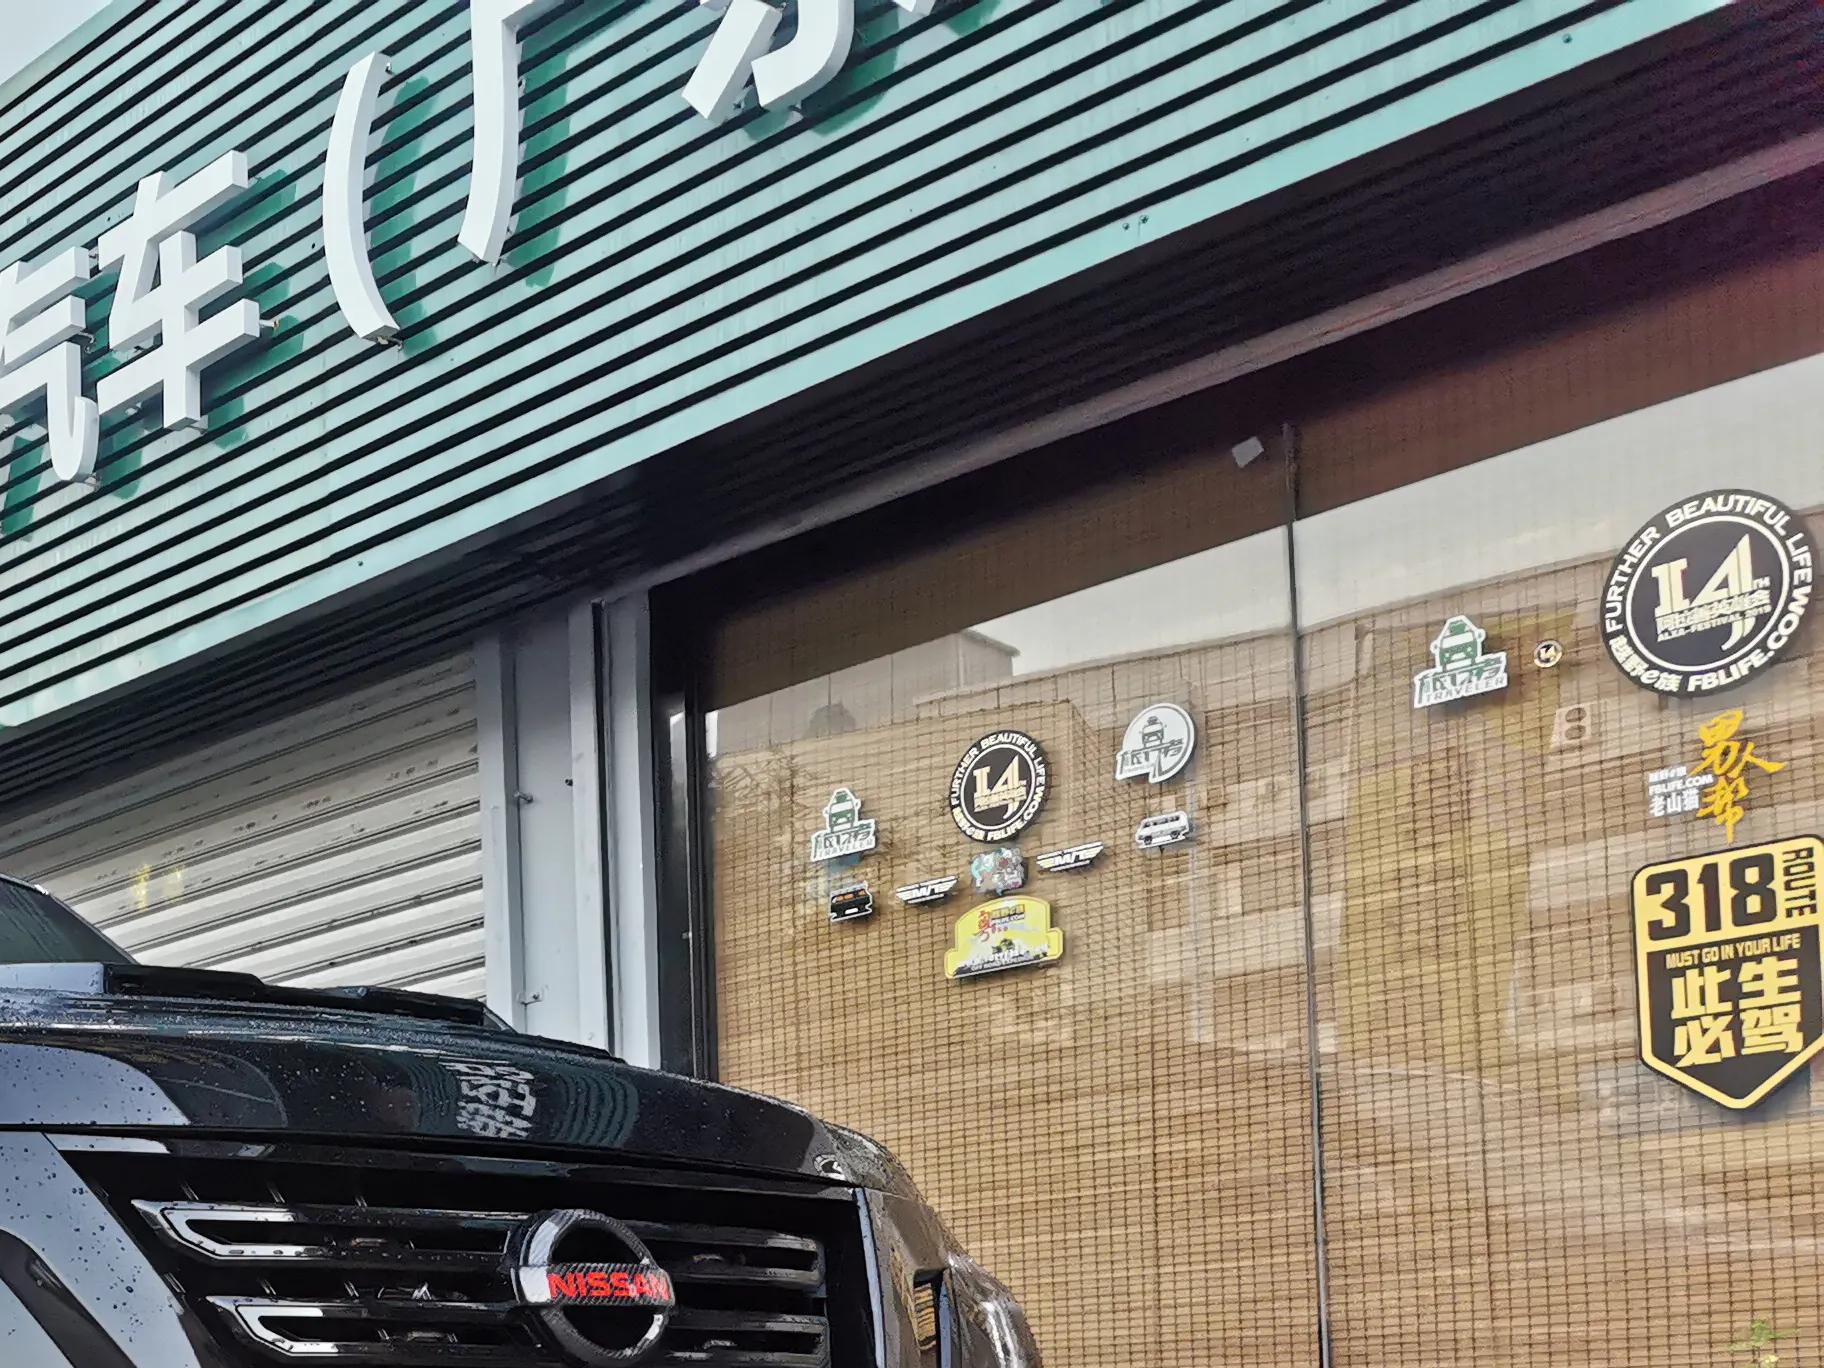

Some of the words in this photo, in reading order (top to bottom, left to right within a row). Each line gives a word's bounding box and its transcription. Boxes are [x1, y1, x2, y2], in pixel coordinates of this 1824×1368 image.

[1665, 495, 1791, 536] BEAUTIFUL
[1605, 526, 1661, 633] FURTHER
[1785, 533, 1813, 586] LIFE
[1687, 585, 1813, 692] FBLIFE.COM
[980, 733, 1037, 758] BEAUTIFUL
[951, 747, 979, 805] FURTHER
[1646, 853, 1776, 941] 318
[1782, 847, 1817, 918] ROUTE
[1666, 948, 1701, 969] MUST
[1702, 945, 1720, 962] GO
[1721, 943, 1735, 960] IN
[1736, 938, 1772, 957] YOUR
[1773, 933, 1801, 951] LIFE
[1671, 956, 1801, 1020] 此生
[1674, 1004, 1804, 1067] 必驾
[548, 1272, 673, 1302] NISSAN
